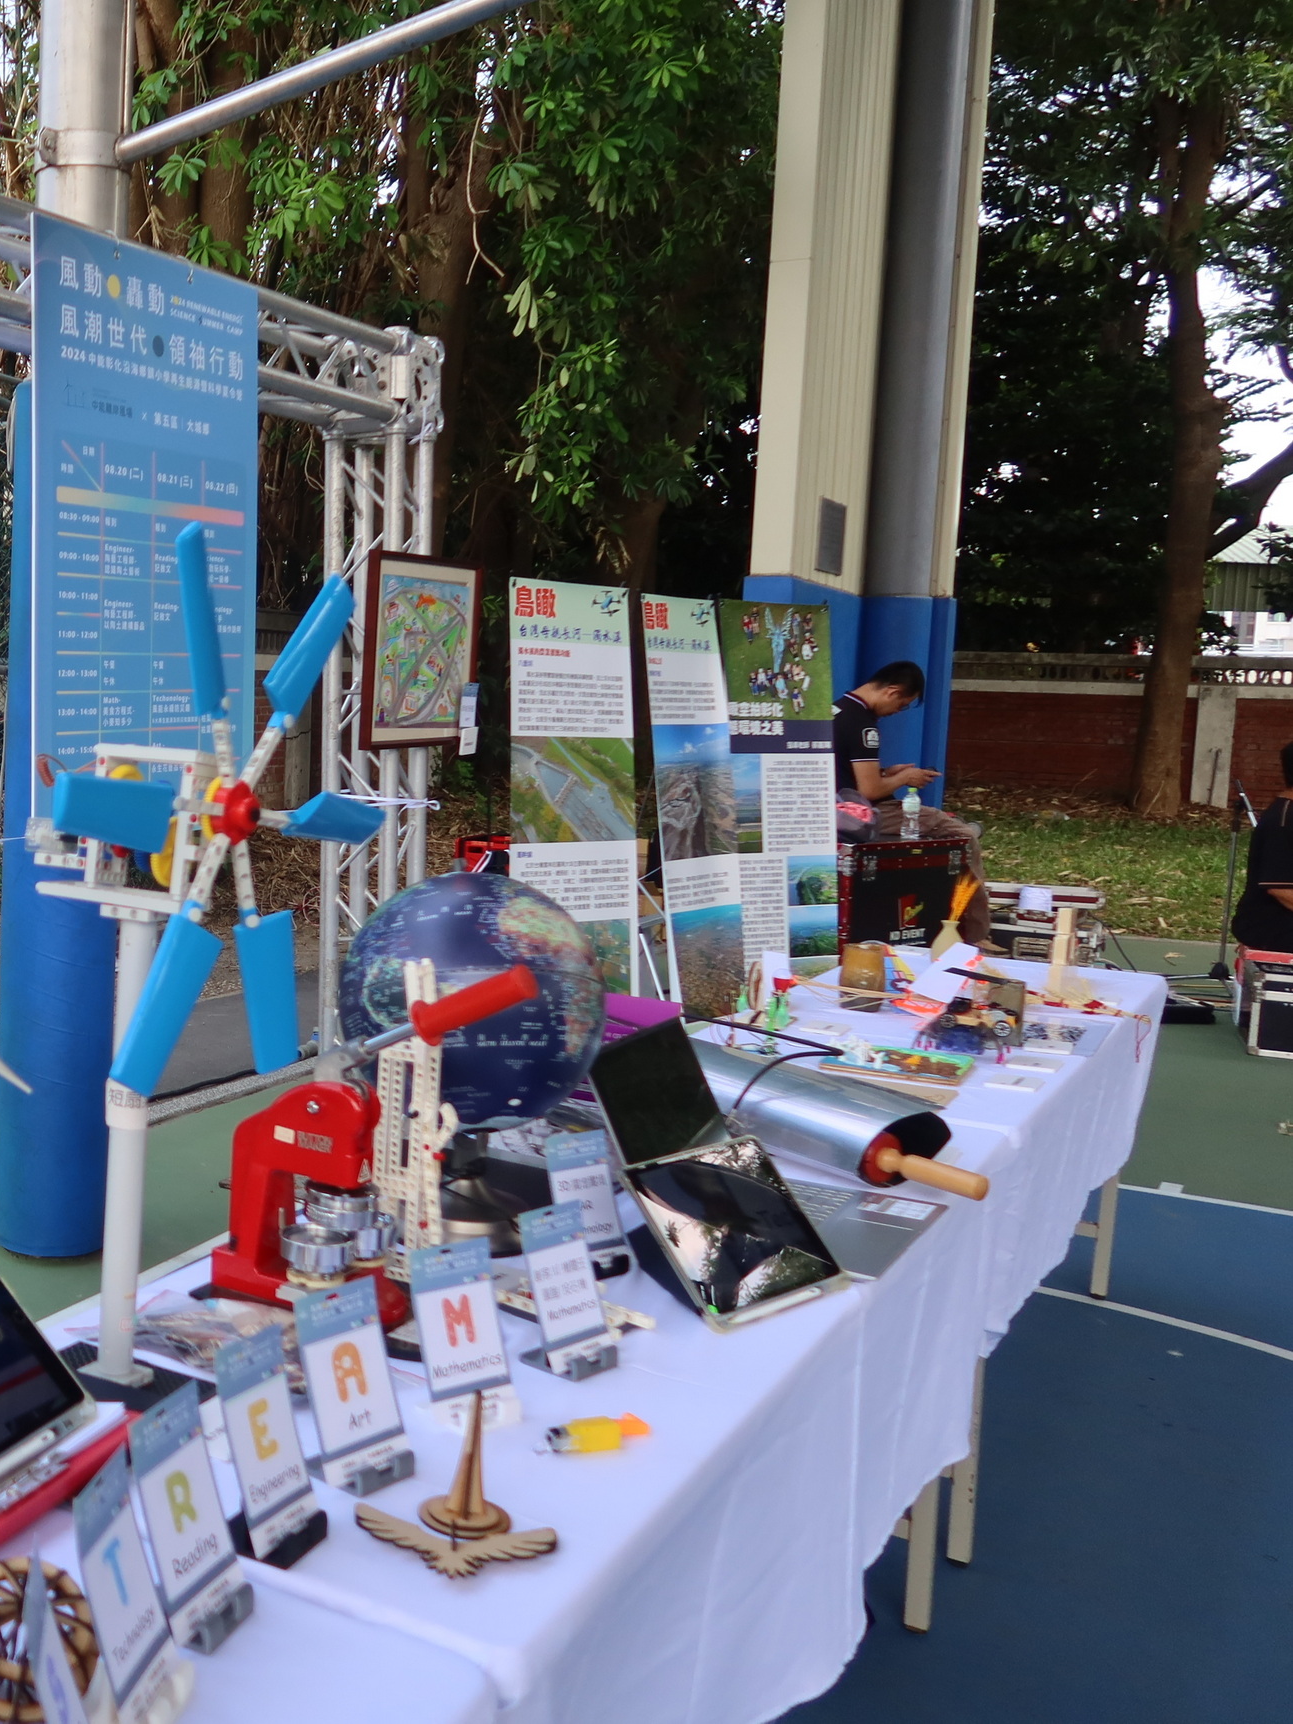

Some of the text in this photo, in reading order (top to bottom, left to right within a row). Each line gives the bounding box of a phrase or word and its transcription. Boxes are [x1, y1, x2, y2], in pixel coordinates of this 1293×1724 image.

[59, 255, 102, 298] 風動
[60, 304, 243, 381] 風潮世代 領袖行動
[61, 345, 86, 362] 2024
[104, 464, 127, 476] 08.20
[514, 585, 556, 618] 鳥瞰
[901, 928, 925, 939] EVENT
[442, 1293, 476, 1347] M
[331, 1341, 368, 1403] A
[432, 1353, 502, 1379] Mathematics
[247, 1397, 279, 1461] E
[348, 1408, 371, 1430] Art
[165, 1469, 198, 1533] R
[249, 1464, 300, 1503] Engineering
[103, 1536, 128, 1606] T
[172, 1533, 218, 1579] Reading
[112, 1606, 155, 1666] Technology
